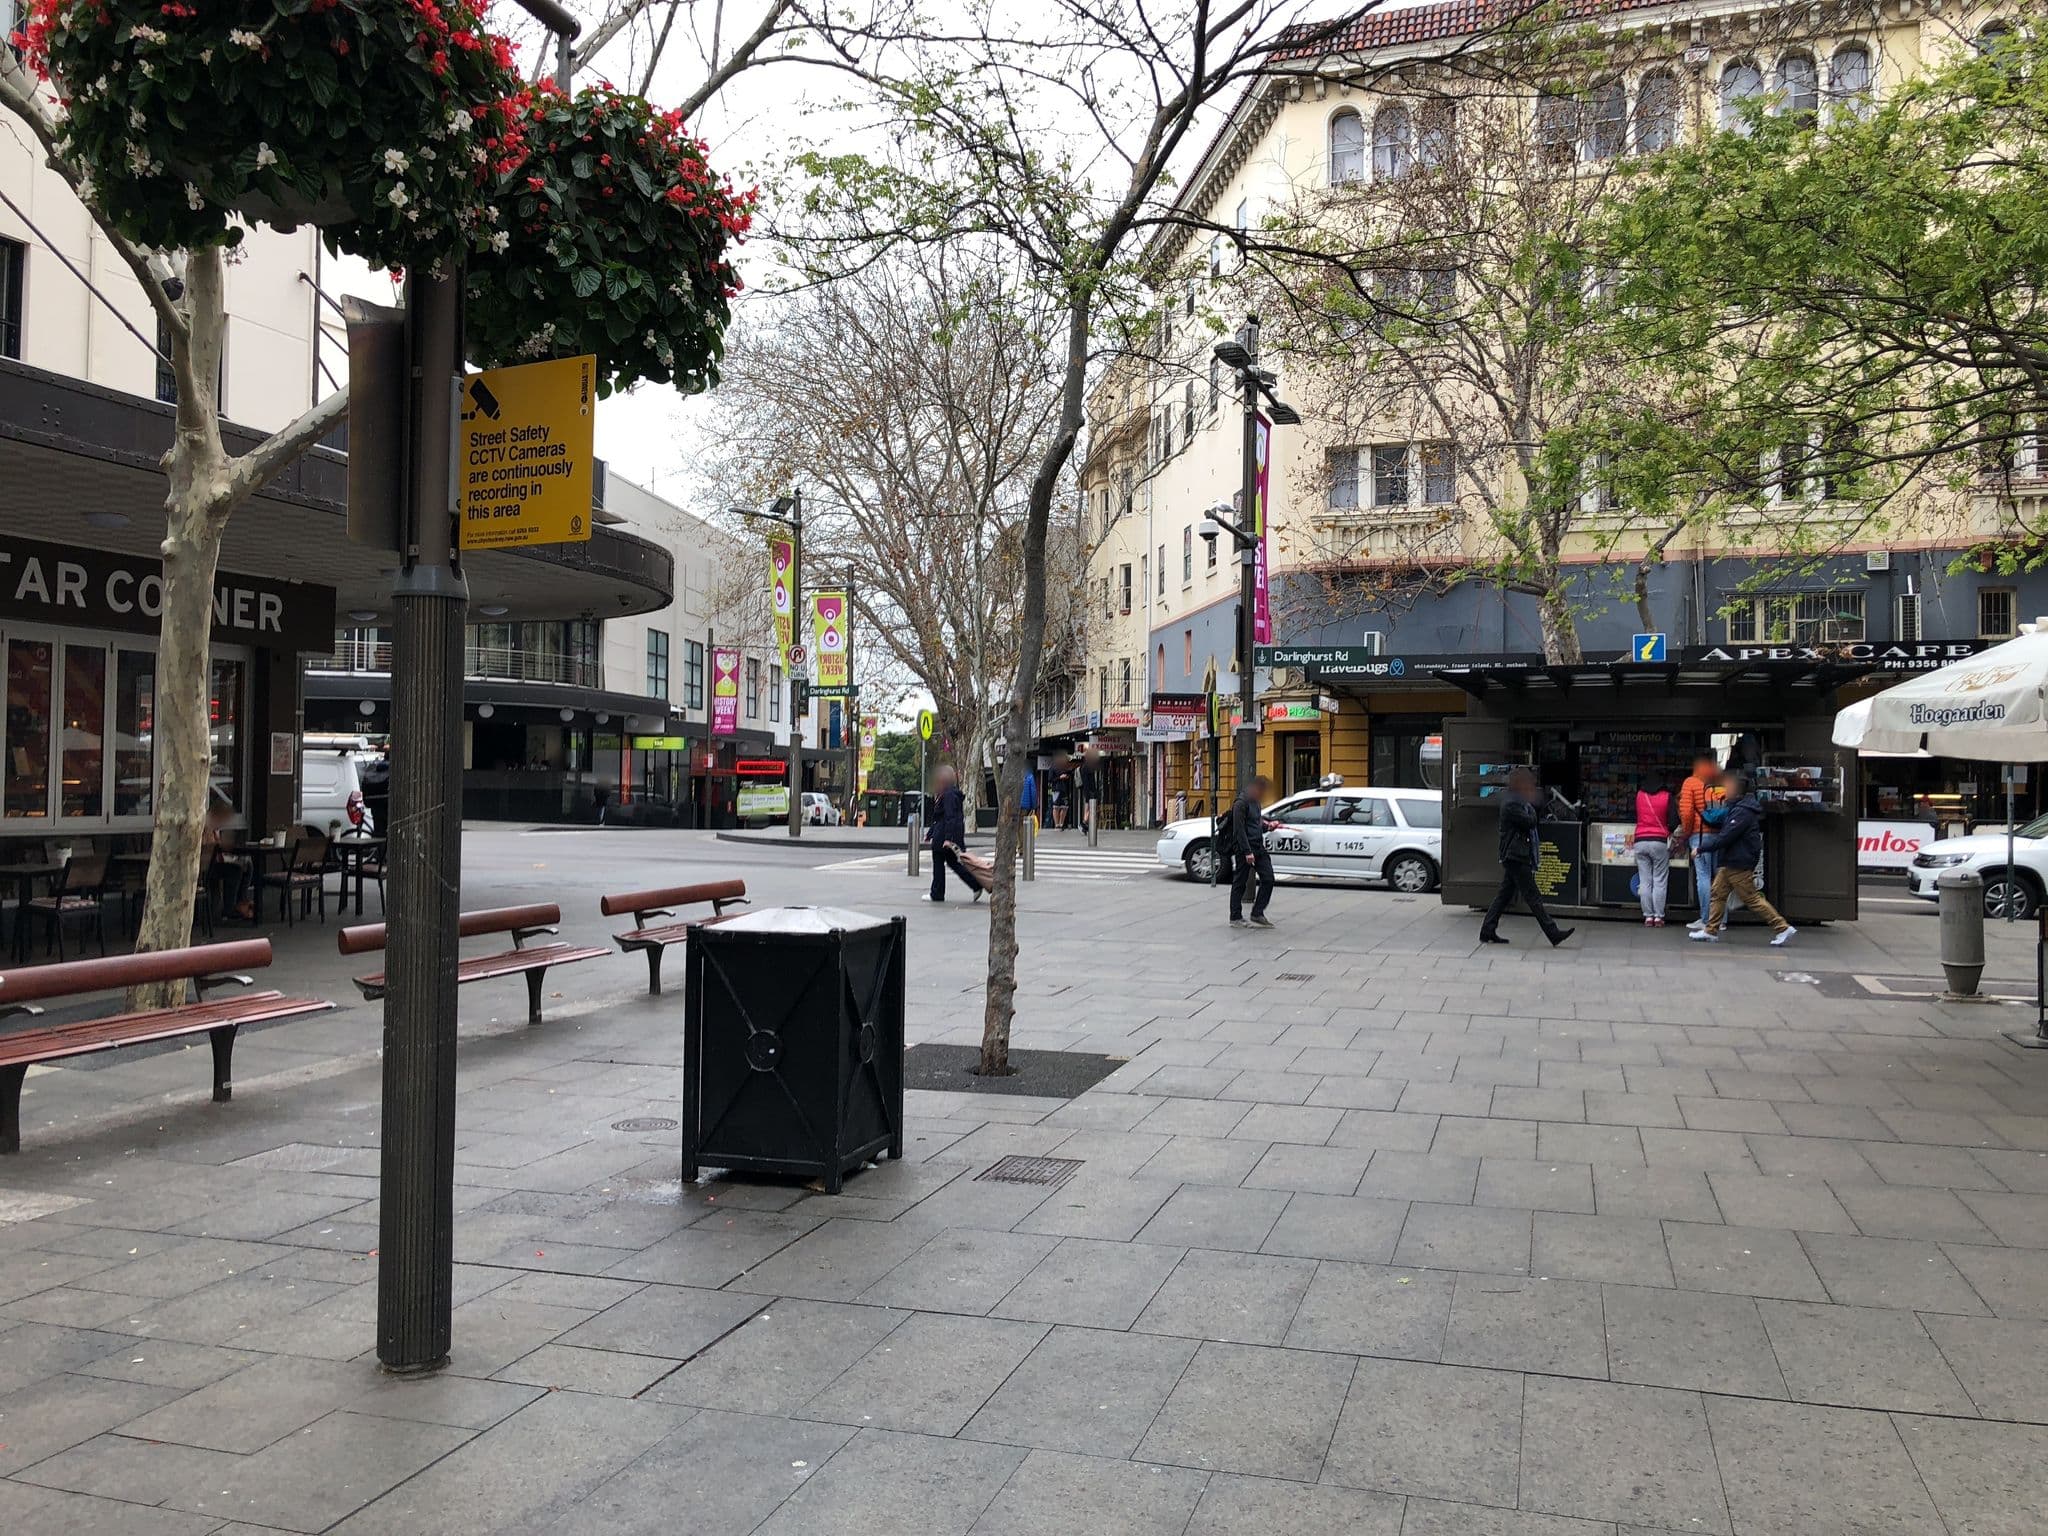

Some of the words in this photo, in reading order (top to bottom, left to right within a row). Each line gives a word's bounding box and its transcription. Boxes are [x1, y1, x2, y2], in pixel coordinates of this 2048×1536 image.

[470, 429, 506, 447] Street
[510, 425, 550, 443] Safety
[469, 447, 506, 465] CCTV
[508, 442, 566, 460] Cameras
[468, 470, 488, 484] are
[492, 459, 573, 482] continuously
[468, 482, 528, 502] recording
[530, 481, 542, 495] in
[467, 506, 490, 520] this
[493, 503, 520, 517] area
[0, 553, 88, 609] AR
[105, 569, 283, 633] CONER
[1274, 651, 1333, 664] Darlinghurst
[1335, 650, 1349, 661] Rd
[1700, 647, 1825, 660] APEX
[1848, 644, 1974, 659] CAFE
[1884, 660, 1905, 669] PH:
[1908, 660, 1938, 669] 9356
[809, 687, 841, 696] Darlinghurst
[1105, 718, 1140, 726] EXCHANGE
[1173, 719, 1192, 727] CUT
[1910, 703, 2005, 727] Hoegaarden
[354, 721, 373, 732] THE
[1336, 842, 1341, 850] T
[1344, 842, 1364, 850] 1475
